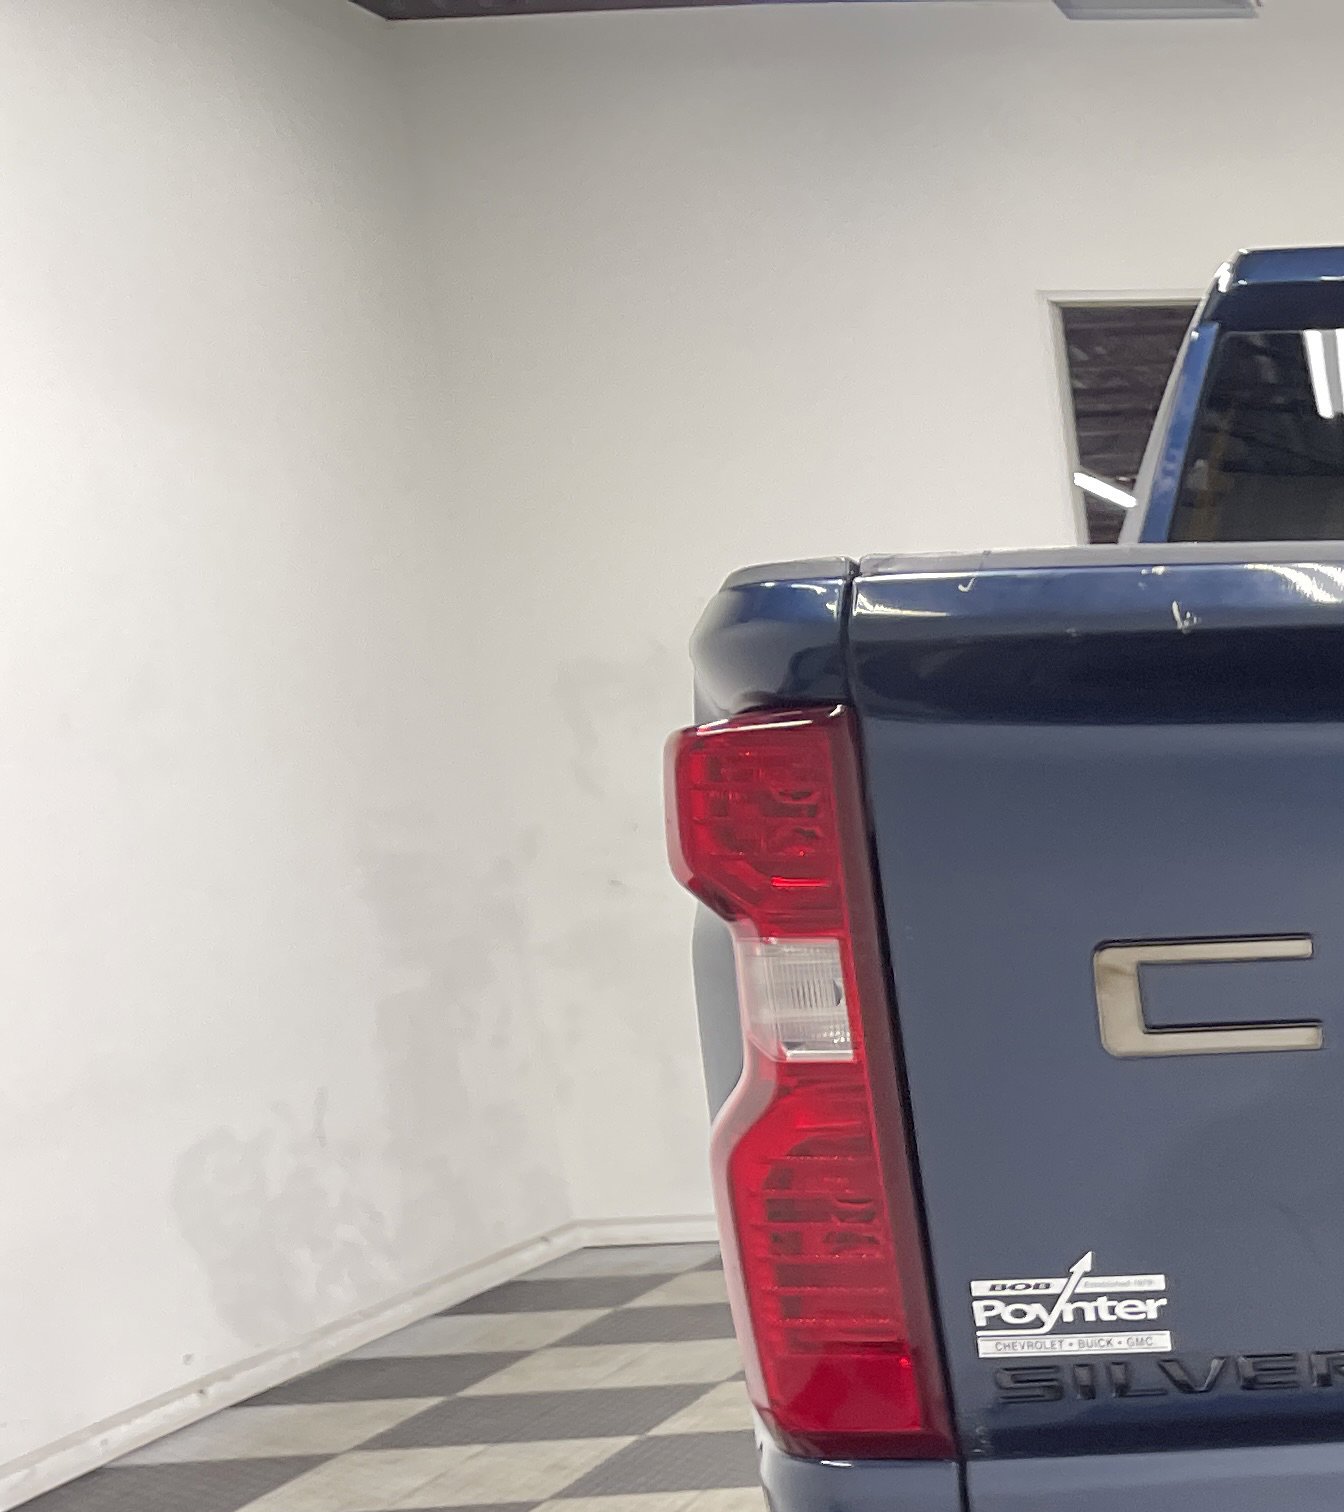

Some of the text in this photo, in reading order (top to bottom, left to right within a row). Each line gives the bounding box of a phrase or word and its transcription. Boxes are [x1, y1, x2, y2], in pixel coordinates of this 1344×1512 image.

[989, 1281, 1051, 1292] BOB
[971, 1295, 1167, 1336] Poynter
[994, 1336, 1153, 1352] CHEVROLET BUICK GMC
